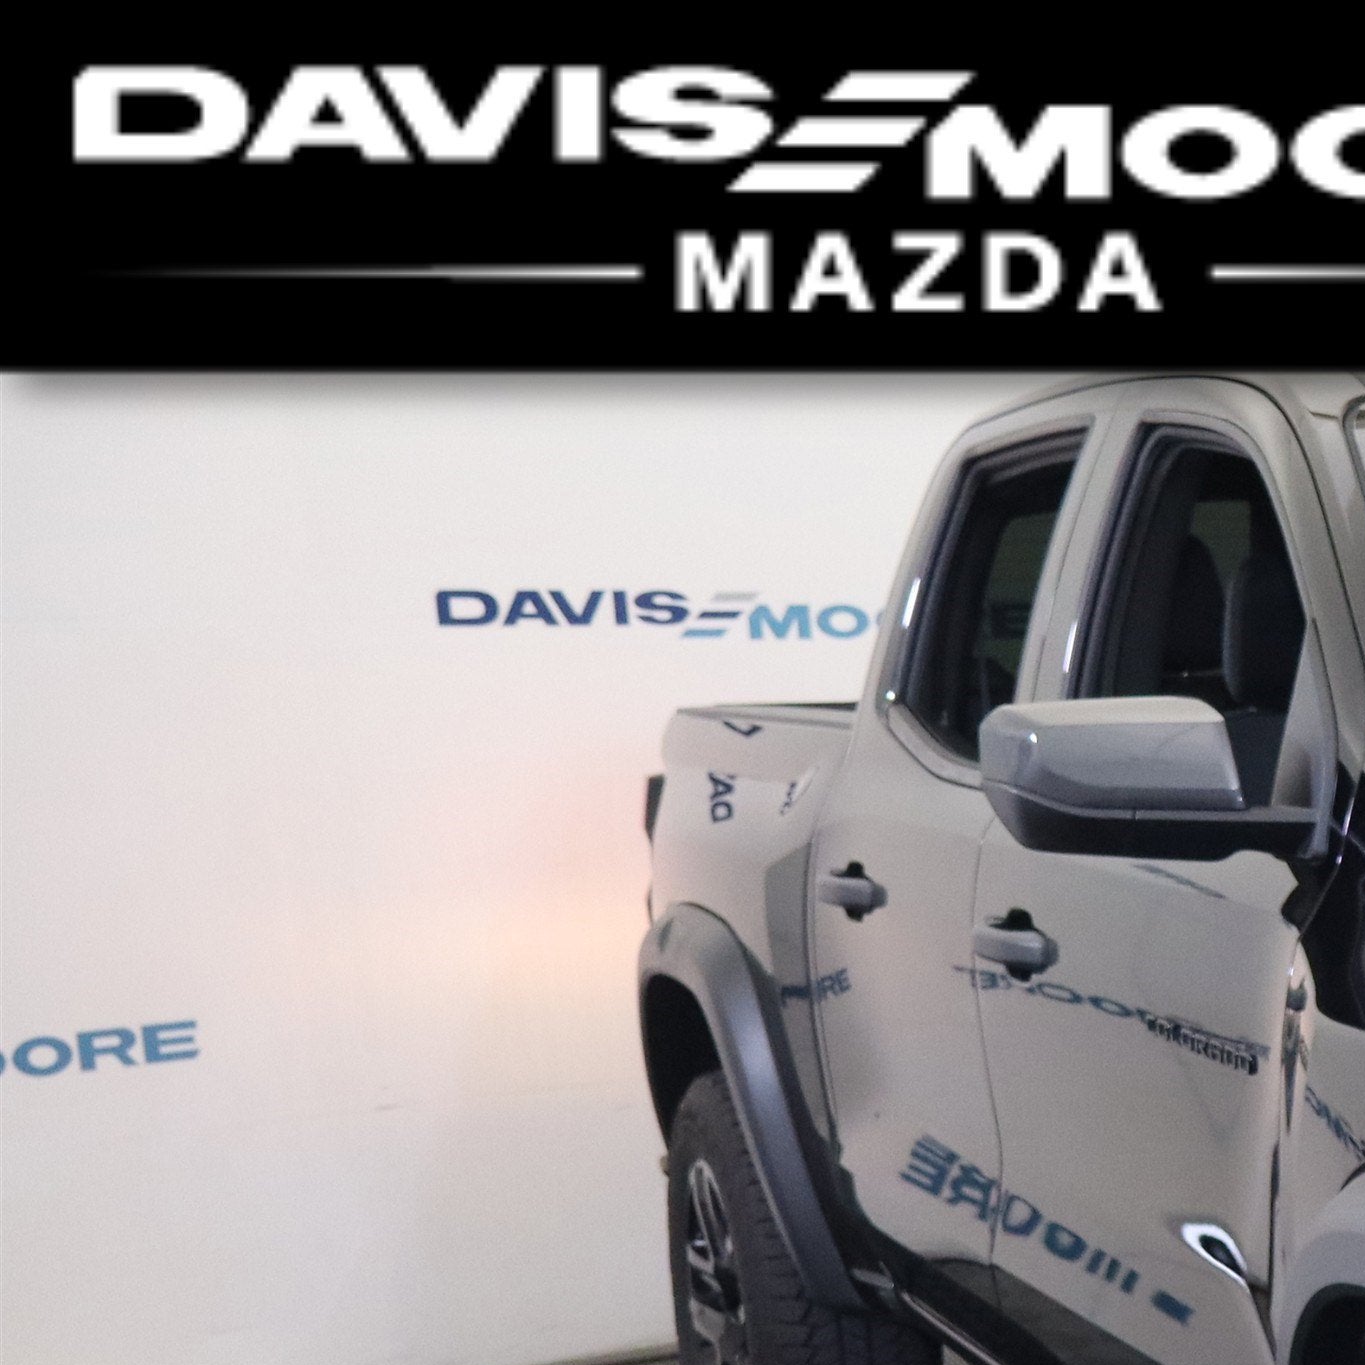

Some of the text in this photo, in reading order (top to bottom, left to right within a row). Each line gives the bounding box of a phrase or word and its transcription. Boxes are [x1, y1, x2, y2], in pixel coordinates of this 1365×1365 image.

[434, 590, 885, 639] DAVIS MO
[0, 1019, 199, 1077] ORE
